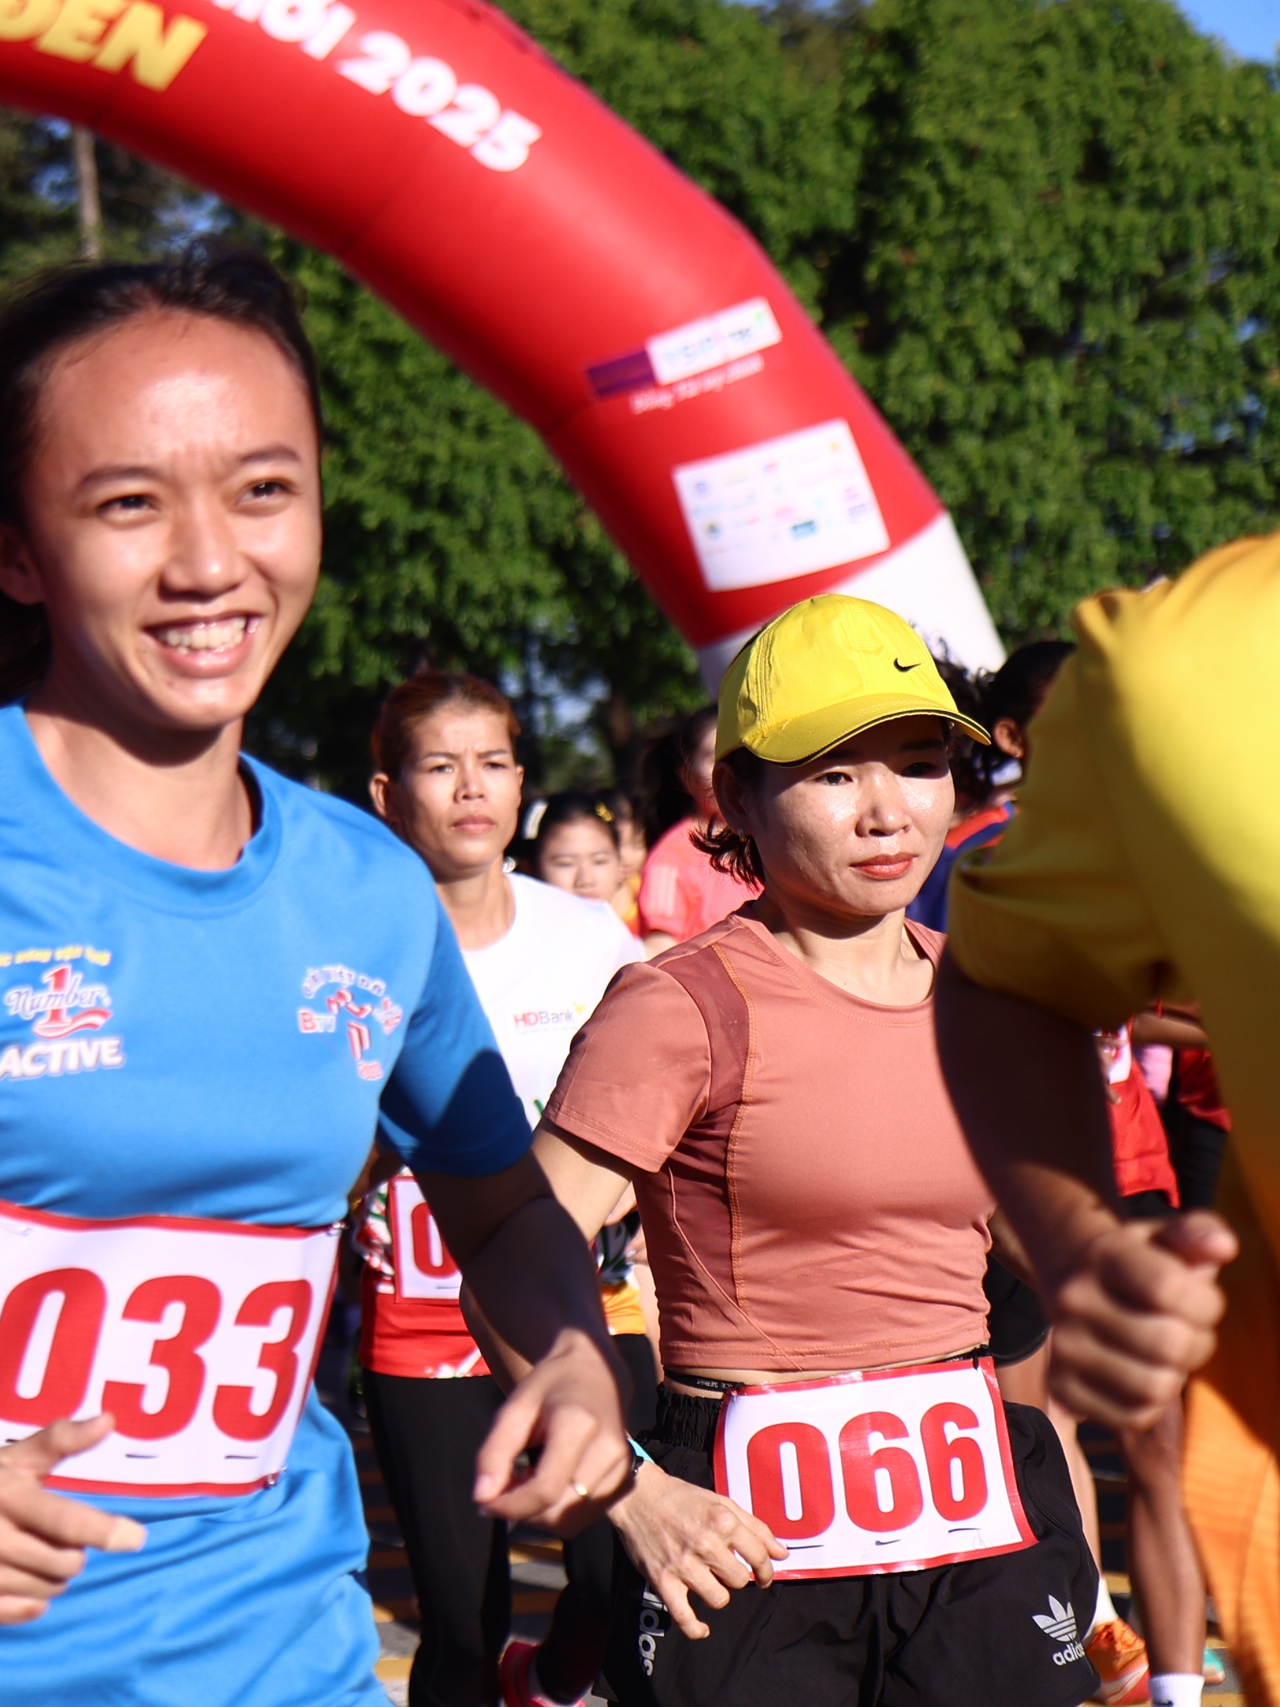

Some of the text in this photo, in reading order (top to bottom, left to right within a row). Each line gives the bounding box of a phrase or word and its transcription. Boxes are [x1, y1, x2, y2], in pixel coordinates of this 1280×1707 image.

[333, 28, 542, 173] 2025
[513, 1009, 574, 1028] HDBank
[747, 1402, 988, 1539] 066
